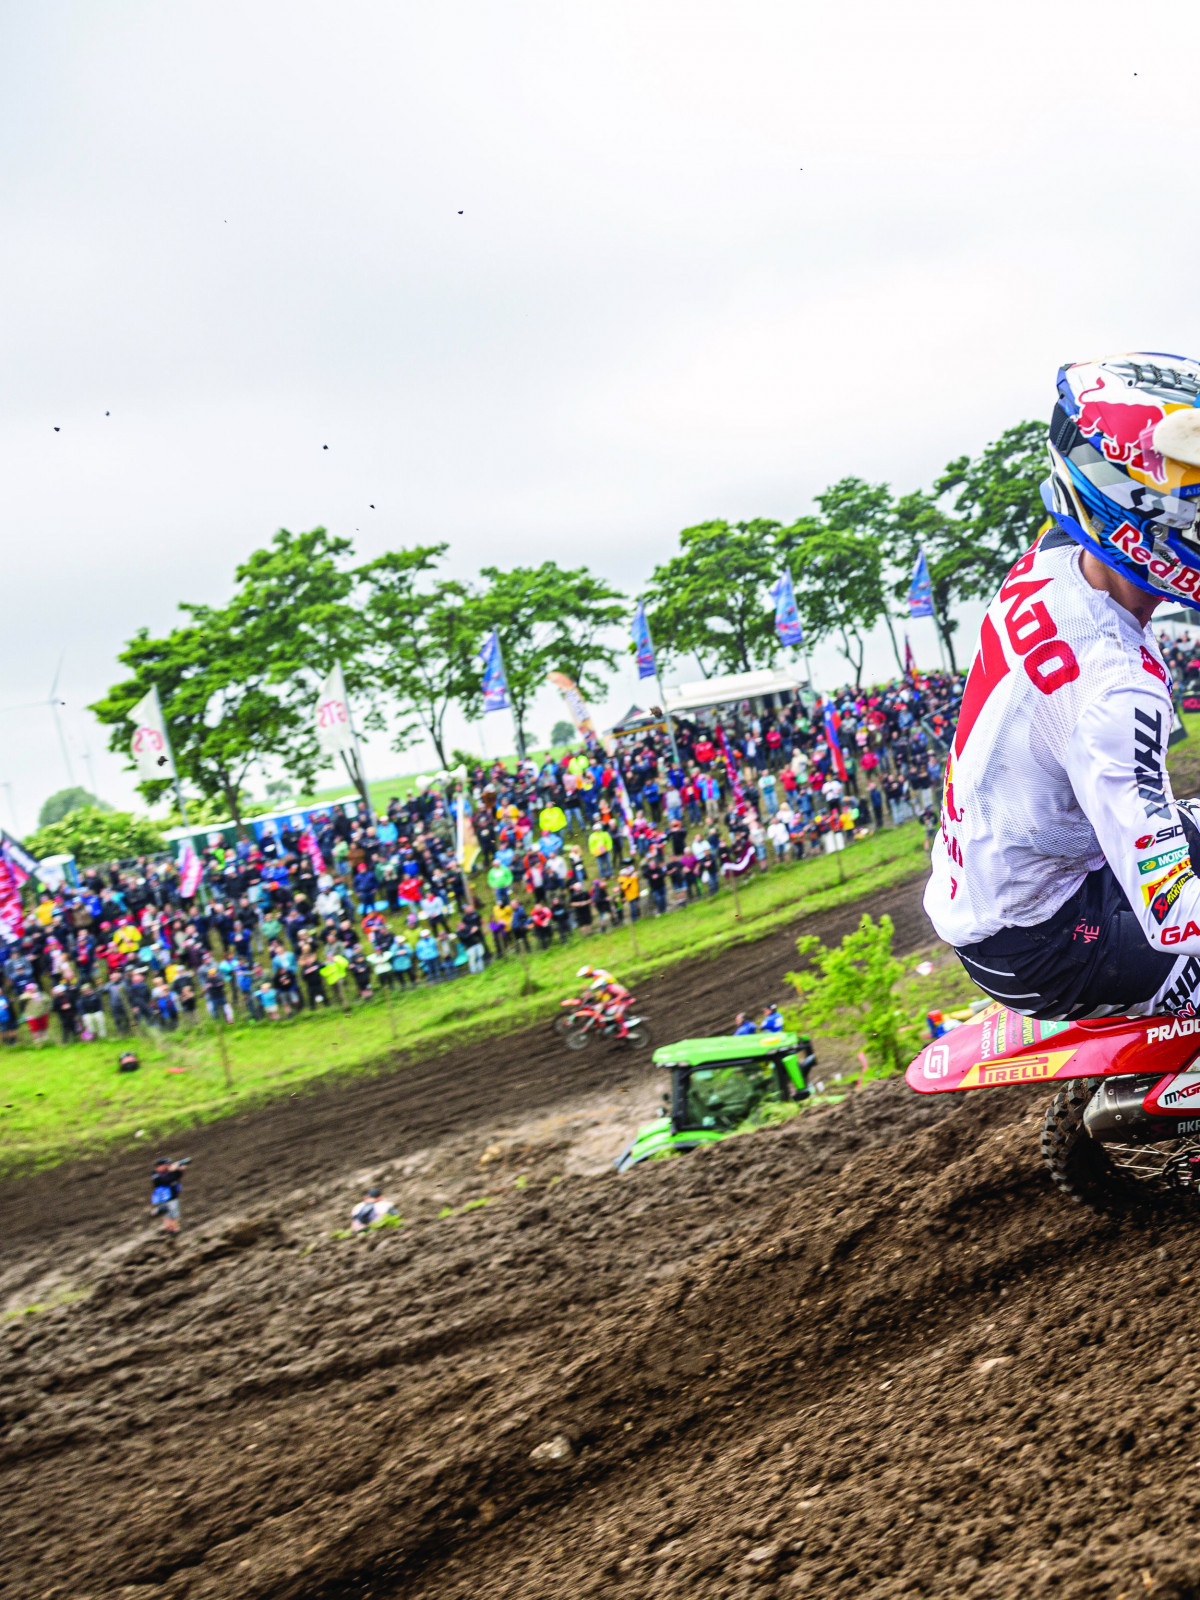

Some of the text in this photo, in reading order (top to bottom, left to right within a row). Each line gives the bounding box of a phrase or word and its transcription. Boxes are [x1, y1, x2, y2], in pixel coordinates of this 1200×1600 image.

[1108, 520, 1180, 586] Red
[980, 1020, 993, 1060] AIROH
[978, 1056, 1049, 1085] PIRELLI
